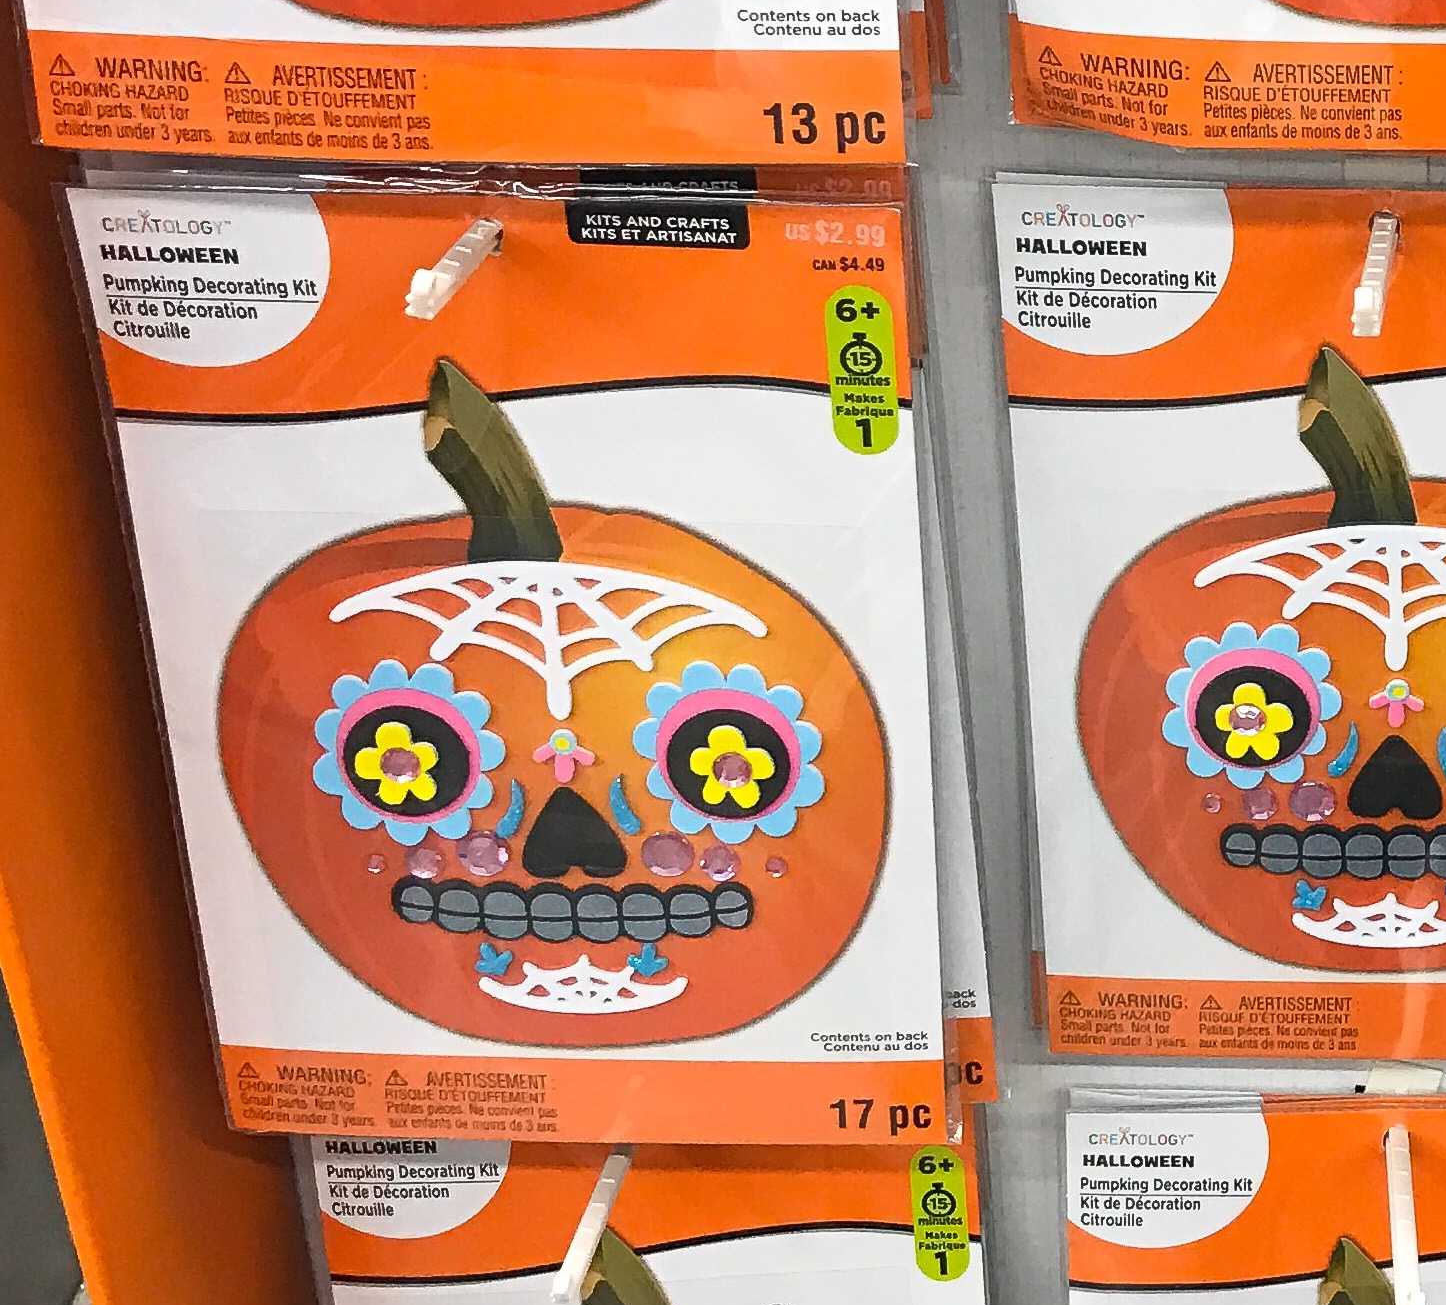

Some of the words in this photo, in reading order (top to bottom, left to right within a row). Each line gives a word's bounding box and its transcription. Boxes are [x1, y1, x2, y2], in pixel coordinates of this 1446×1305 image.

[737, 8, 809, 23] Contents
[816, 10, 835, 23] on
[841, 7, 880, 23] back
[753, 23, 820, 37] Contenu
[825, 24, 845, 37] au
[849, 22, 881, 37] dos
[1040, 67, 1104, 91] CHOKING
[1109, 79, 1169, 99] HAZARD
[1204, 86, 1261, 103] RISQUE
[1204, 103, 1247, 122] Petites
[1300, 105, 1317, 121] Ne
[1321, 105, 1375, 121] convient
[762, 102, 819, 144] 13
[836, 109, 887, 153] pc
[1230, 123, 1278, 140] enfants
[1282, 123, 1297, 140] de
[1345, 123, 1360, 141] de
[1364, 124, 1372, 140] 3
[586, 215, 621, 226] KITS
[627, 216, 662, 228] AND
[667, 217, 730, 230] CRAFTS
[100, 245, 239, 265] HALLOWEEN
[1016, 237, 1147, 257] HALLOWEEN
[813, 259, 836, 270] CAN
[840, 257, 885, 273] $4.49
[1016, 291, 1039, 306] Kit
[1043, 292, 1063, 307] de
[1069, 291, 1157, 310] Décoration
[835, 298, 880, 322] 6+
[1018, 312, 1091, 329] Citrouille
[810, 1032, 870, 1042] Contents
[896, 1031, 928, 1041] back
[830, 1099, 874, 1129] 17
[889, 1104, 932, 1136] pc
[325, 1141, 437, 1155] HALLOWEEN
[919, 1156, 954, 1174] 6+
[1083, 1155, 1194, 1168] HALLOWEEN
[327, 1165, 394, 1181] Pumpking
[400, 1164, 476, 1180] Decorating
[480, 1162, 499, 1177] Kit
[1080, 1213, 1144, 1227] Citrouille
[935, 1251, 948, 1275] 1
